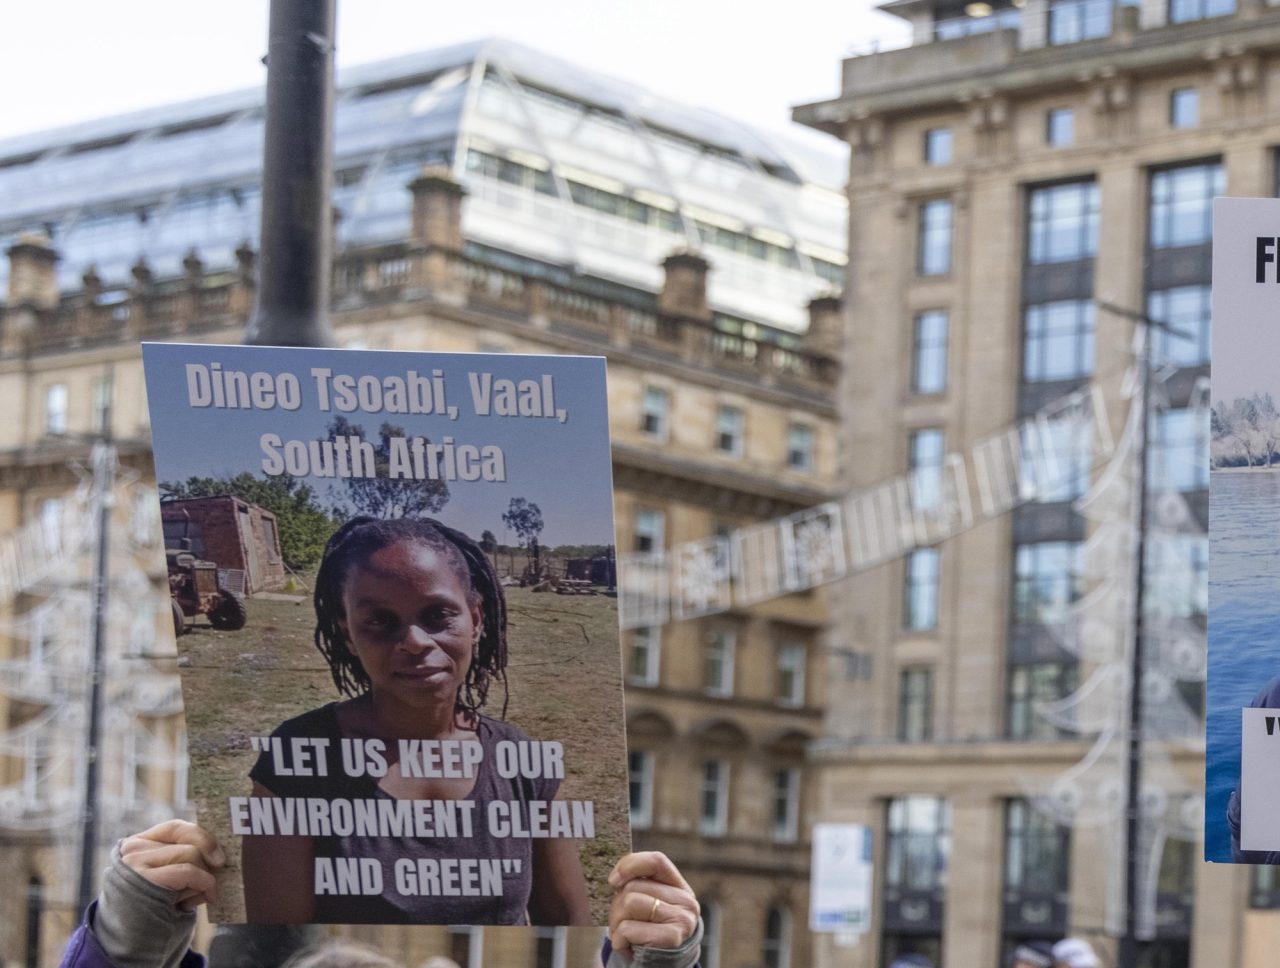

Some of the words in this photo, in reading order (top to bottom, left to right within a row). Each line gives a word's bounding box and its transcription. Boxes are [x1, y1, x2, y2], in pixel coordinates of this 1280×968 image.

[185, 363, 302, 411] Dineo
[310, 367, 459, 421] Tsoabi,
[468, 372, 568, 422] Vaal,
[259, 434, 376, 479] South
[388, 437, 507, 483] Africa
[250, 736, 330, 777] "LET
[342, 738, 386, 779] US
[398, 739, 484, 779] KEEP
[496, 740, 565, 780] OUR
[229, 797, 476, 838] ENVIRONMENT
[487, 800, 595, 839] CLEAN
[313, 857, 384, 896] AND
[395, 858, 523, 898] GREEN"
